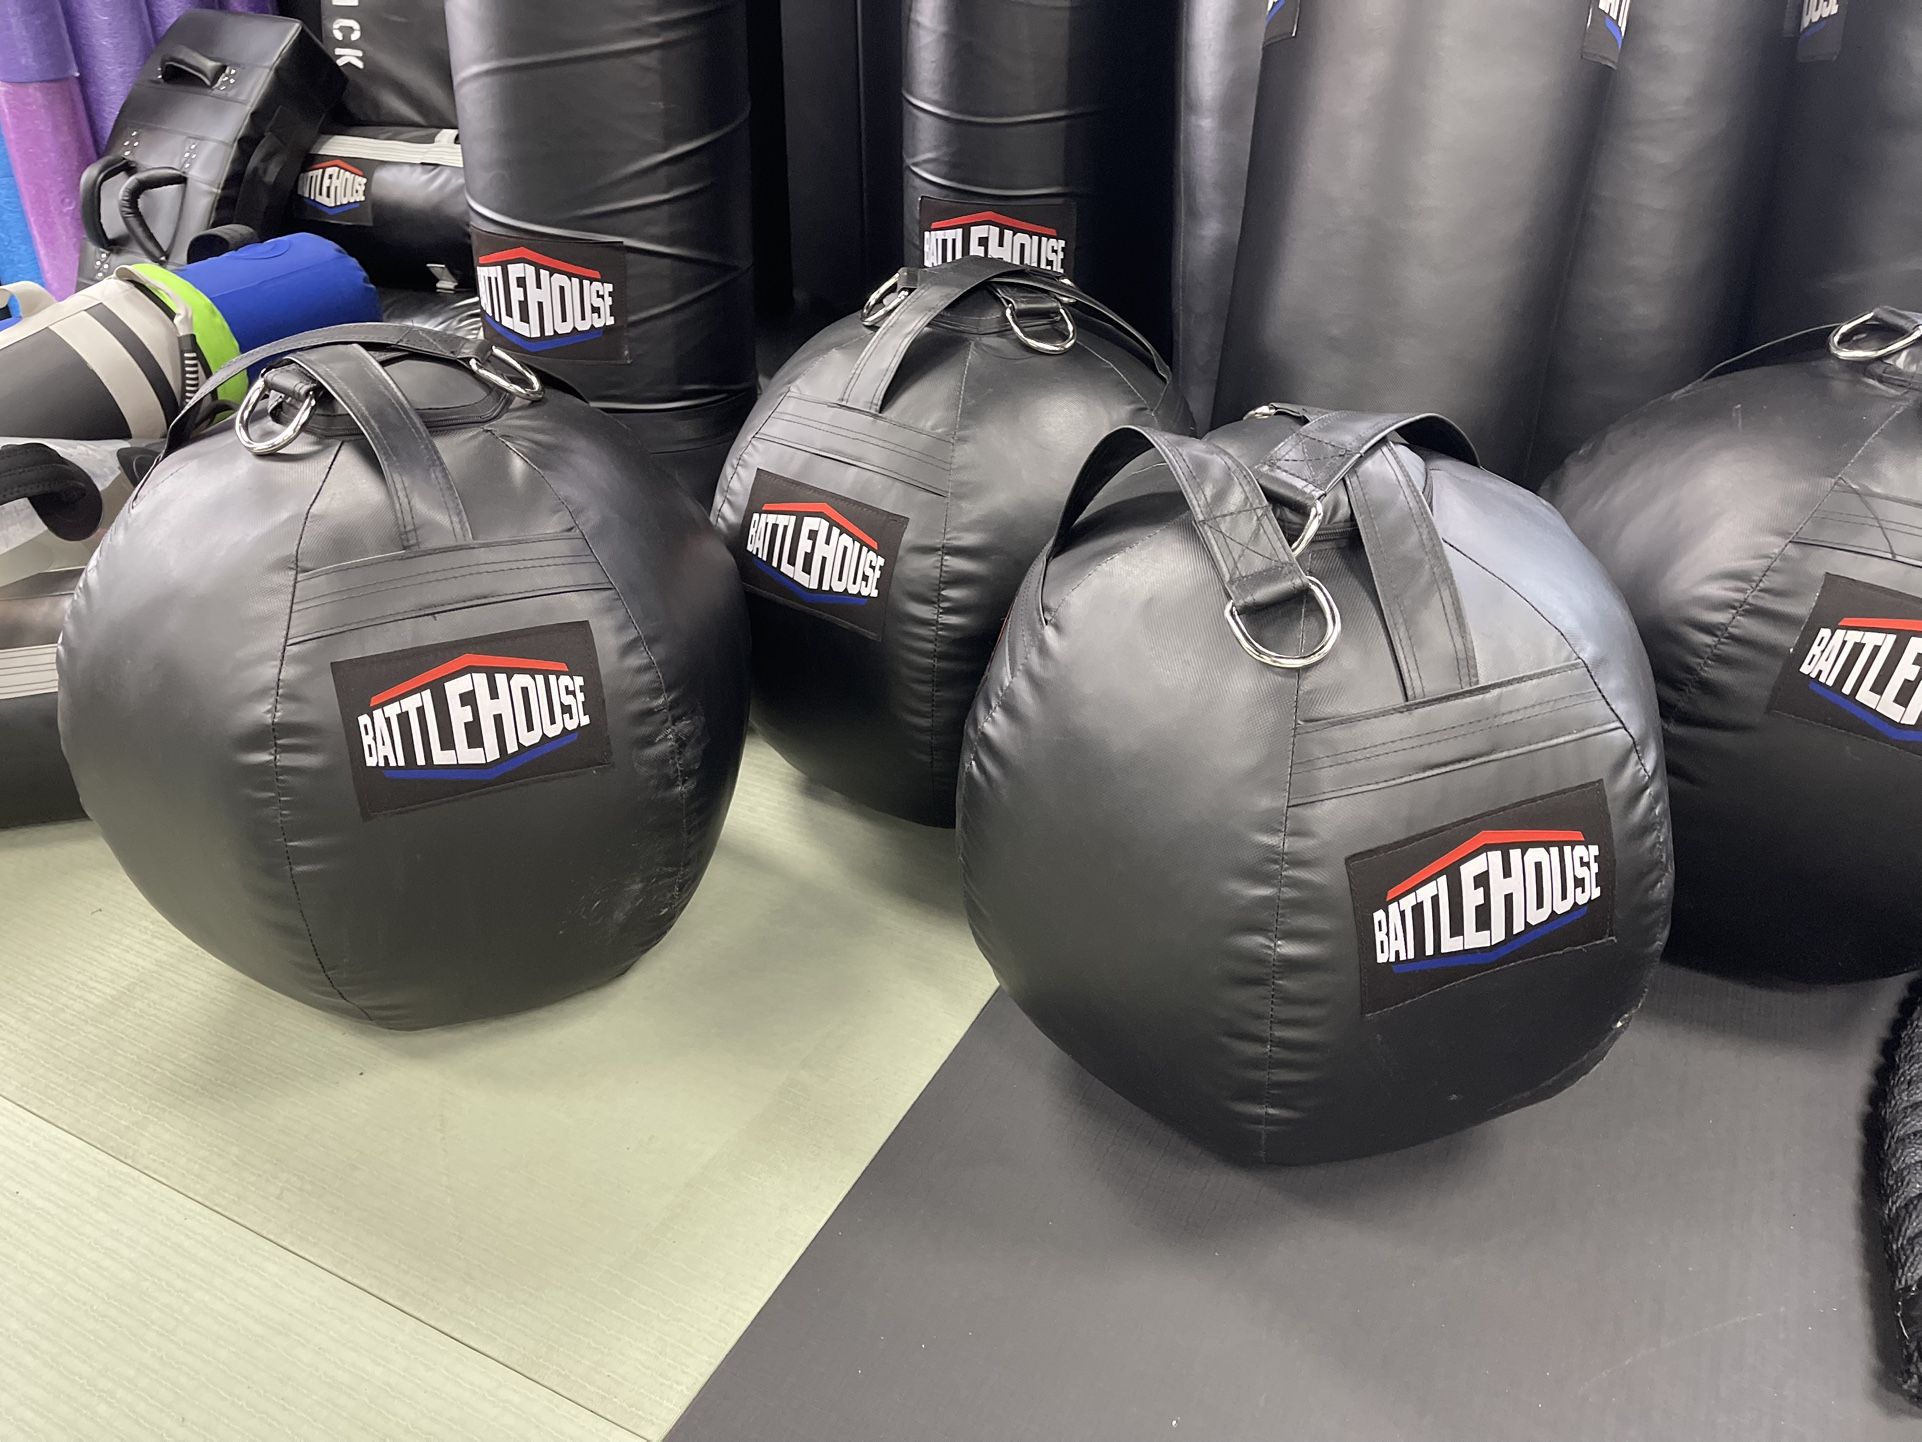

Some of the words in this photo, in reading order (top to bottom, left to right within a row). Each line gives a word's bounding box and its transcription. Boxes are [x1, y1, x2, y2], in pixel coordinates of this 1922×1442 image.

[746, 512, 886, 598] BATTLEHOUSE
[357, 672, 591, 767] BATTLEHOUSE
[1799, 627, 1922, 726] BATTLE
[1372, 844, 1601, 964] BATTLEHOUSE
